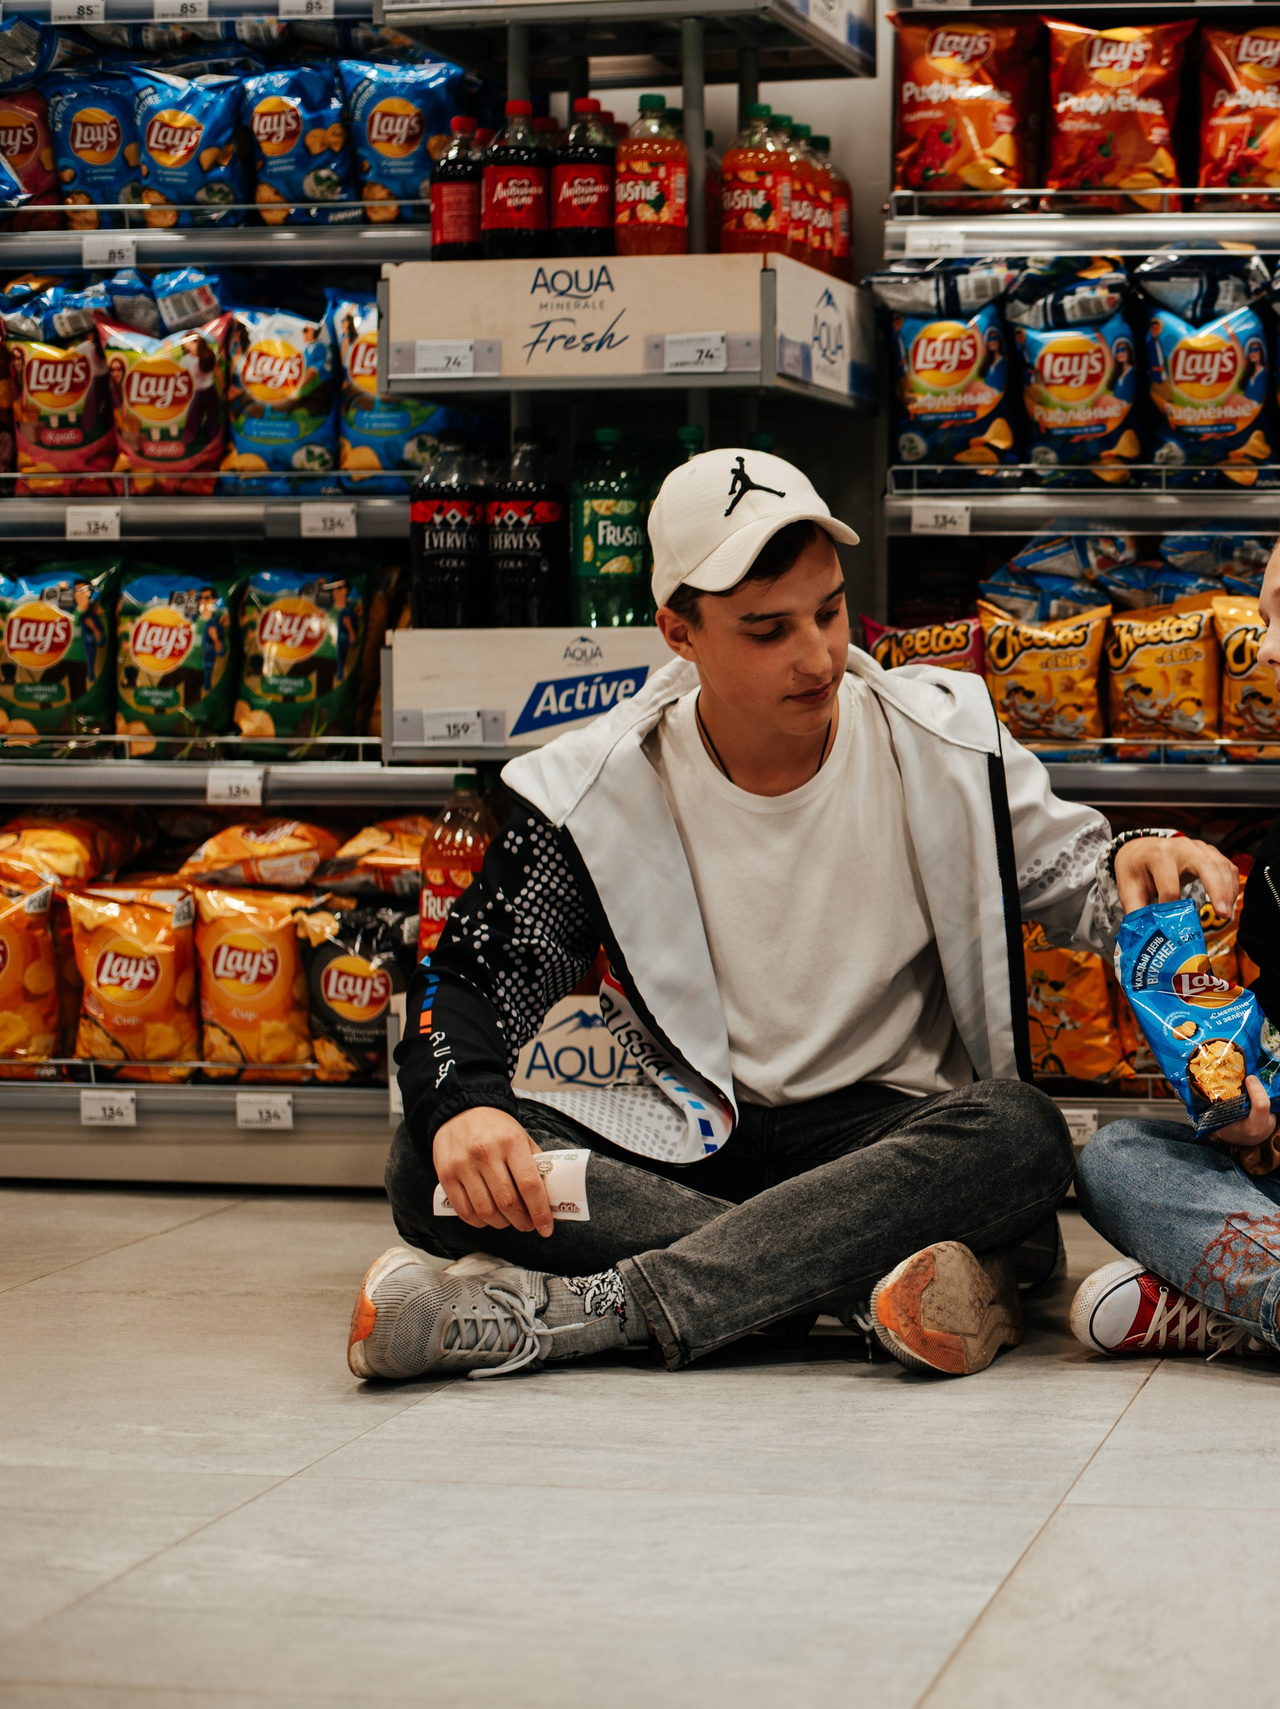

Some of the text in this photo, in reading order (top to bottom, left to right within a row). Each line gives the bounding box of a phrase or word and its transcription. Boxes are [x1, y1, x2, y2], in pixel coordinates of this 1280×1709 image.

[77, 5, 94, 17] 85
[931, 31, 990, 63] Lay's
[1088, 38, 1147, 72] Lay's
[0, 123, 37, 156] ay's
[74, 122, 118, 152] Lay's
[149, 121, 201, 157] Lay's
[253, 107, 299, 145] Lay's
[369, 111, 422, 147] Lay's
[531, 264, 614, 299] AQUA
[539, 300, 605, 311] MINERALE
[522, 307, 629, 365] Fresh
[812, 313, 846, 365] AQUA
[916, 336, 975, 374] Lay's
[246, 349, 302, 389] Lay's
[696, 349, 714, 362] 74
[1045, 349, 1103, 388] Lay's
[1174, 347, 1235, 387] Lay's
[29, 357, 88, 396] Lay's
[129, 371, 192, 409] Lay's
[913, 392, 995, 411] ифлёные
[1034, 403, 1124, 425] Рифлёные
[10, 617, 68, 655] Lay's
[135, 620, 191, 660] Lay's
[261, 609, 322, 649] Lay's
[873, 621, 971, 669] Cheetos
[989, 623, 1091, 671] Cheetos
[1108, 614, 1203, 673] Cheetos
[564, 646, 603, 663] AQUA
[446, 722, 470, 736] 159
[99, 951, 156, 991] Lay's
[215, 944, 269, 985] Lay's
[1135, 936, 1164, 990] КАЖДЫЙ ДЕНЬ
[1147, 940, 1178, 986] ВКУСНЕЕ
[328, 967, 387, 1008] Lay's
[1181, 973, 1230, 997] Lay
[599, 992, 673, 1078] RUSSIA
[526, 1042, 641, 1088] AQUA
[560, 1203, 577, 1213] 100
